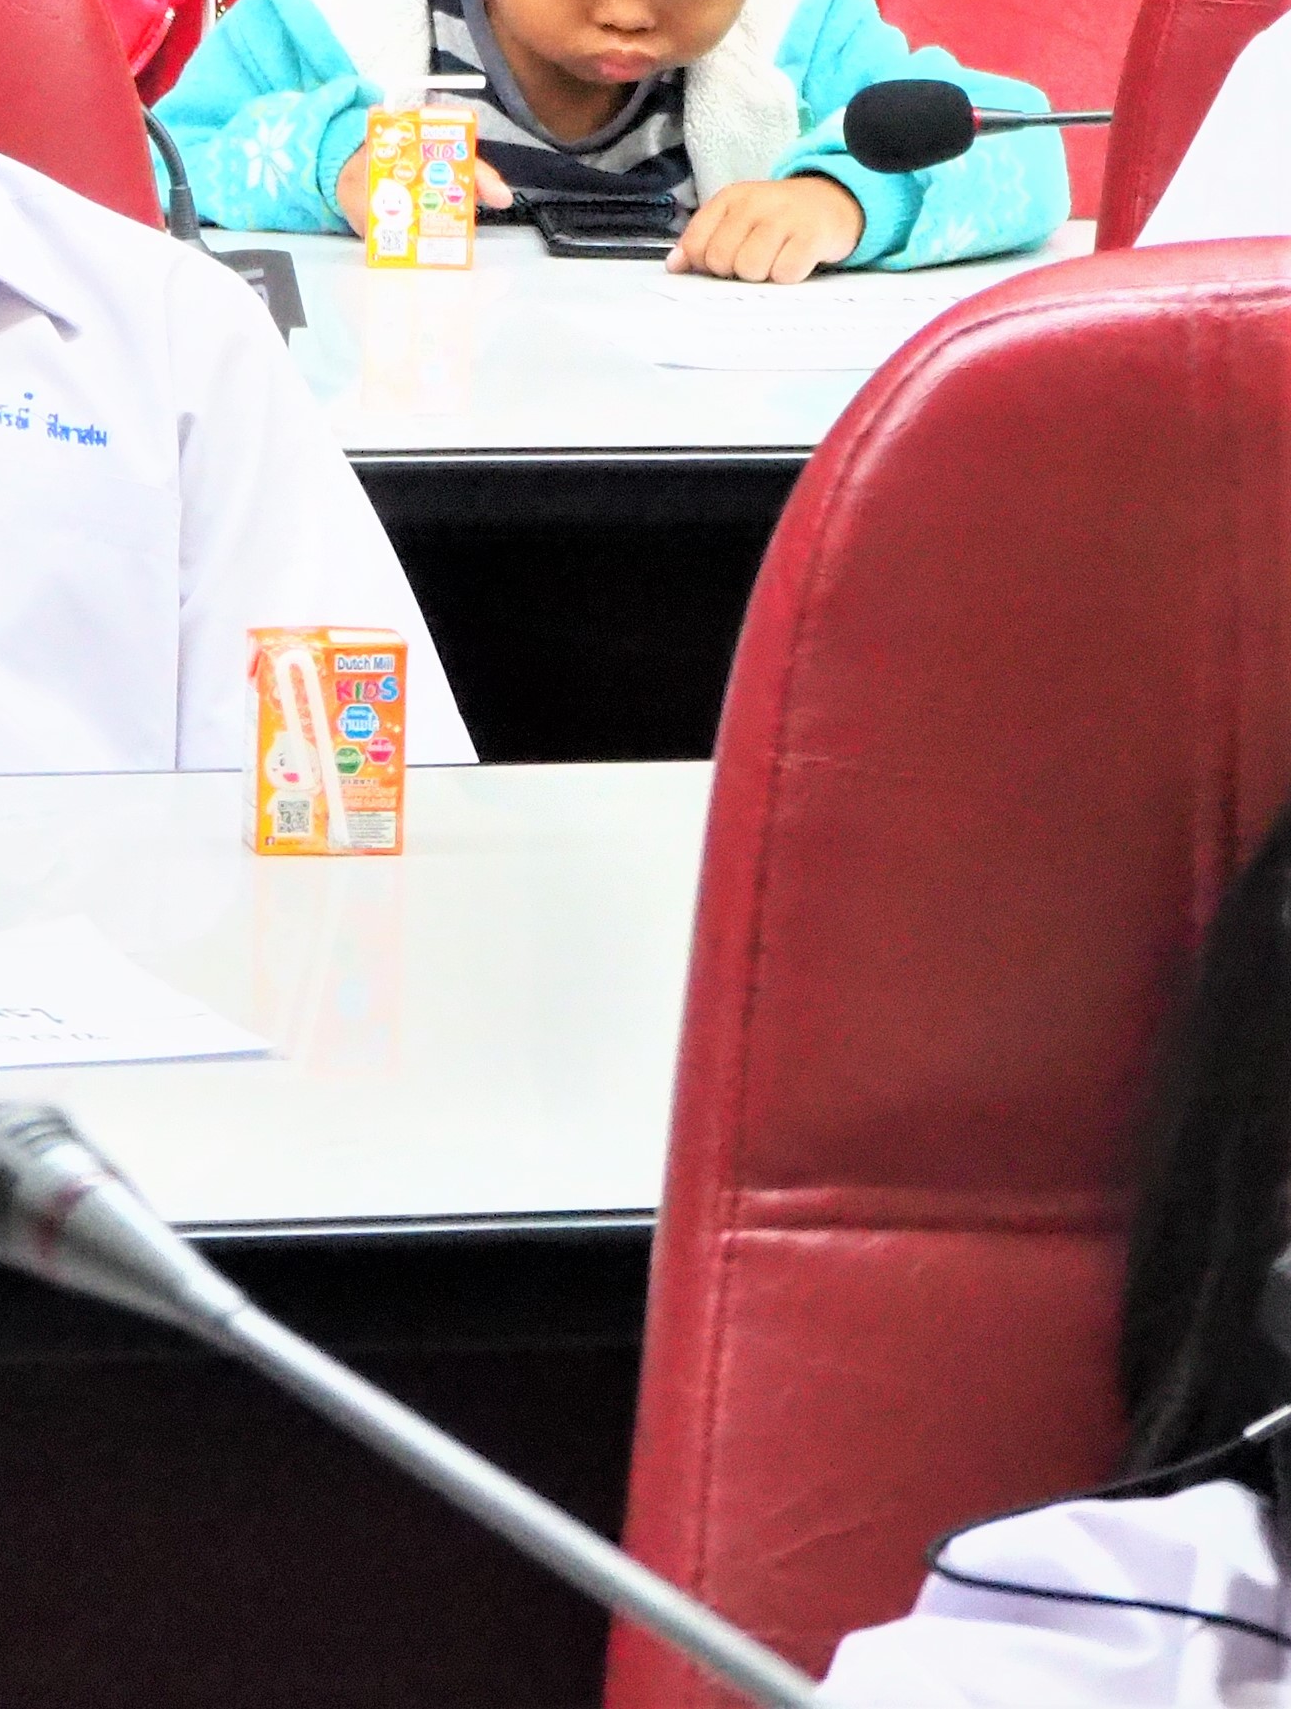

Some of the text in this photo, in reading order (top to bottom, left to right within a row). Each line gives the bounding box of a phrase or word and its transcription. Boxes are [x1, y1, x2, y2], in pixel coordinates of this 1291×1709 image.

[421, 143, 466, 160] KIDS
[336, 656, 370, 671] Dutch
[335, 676, 399, 703] KIDS
